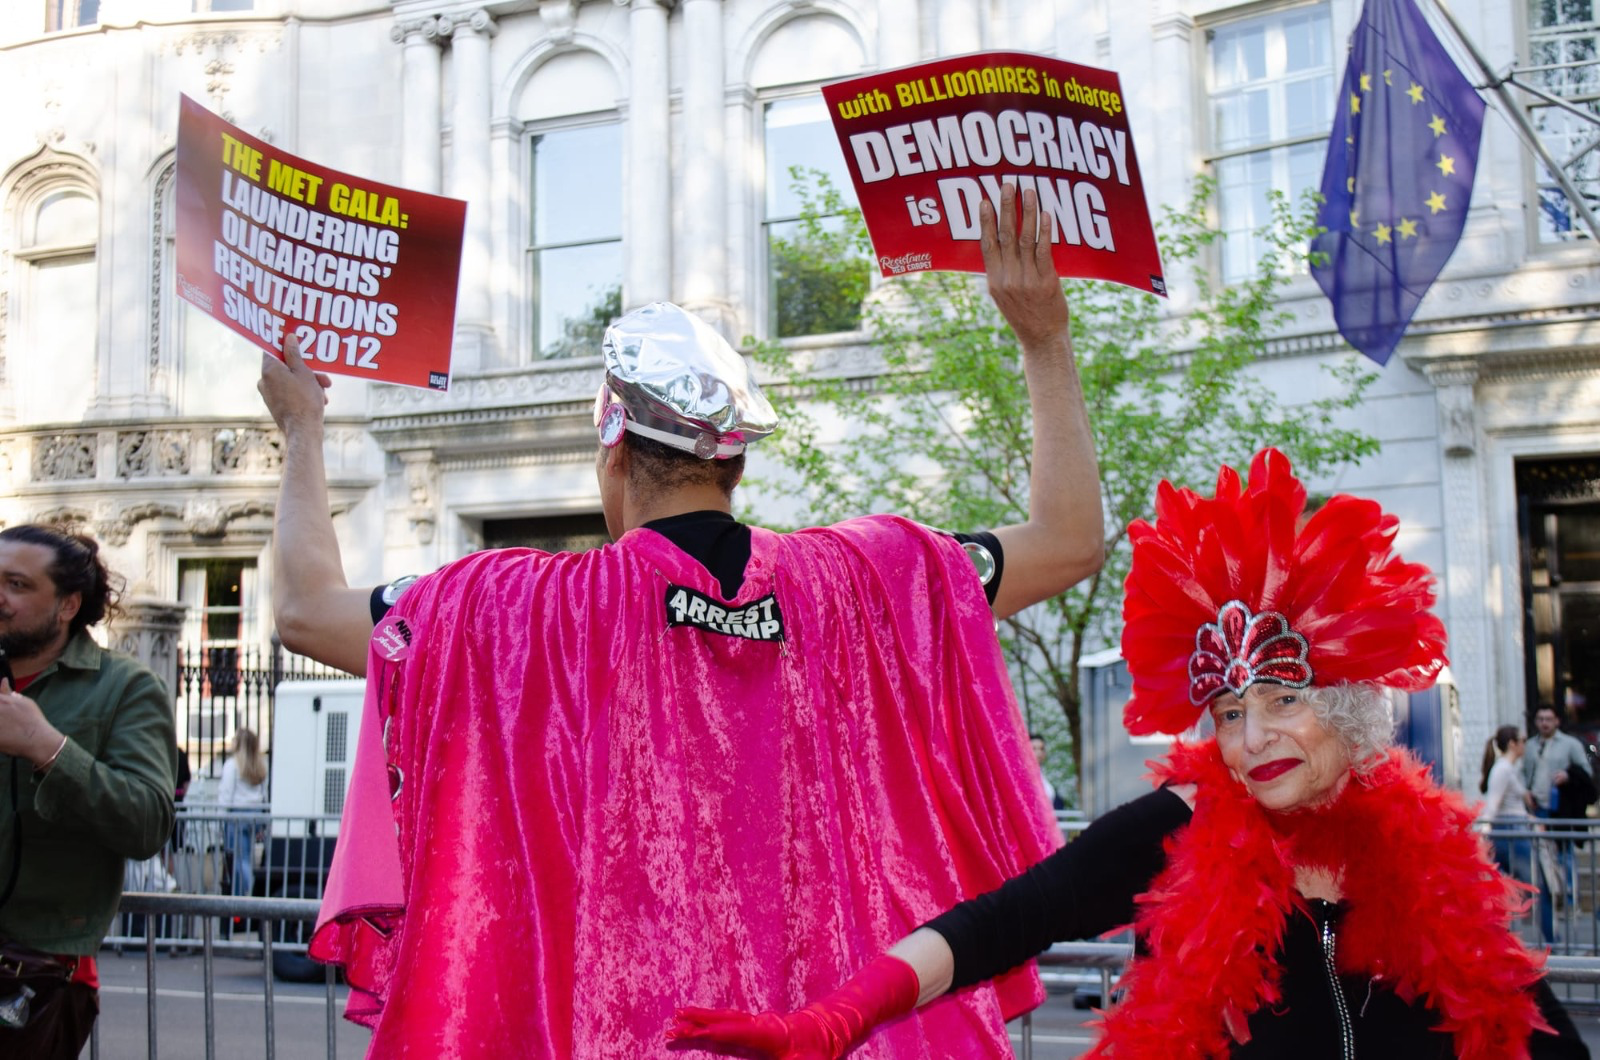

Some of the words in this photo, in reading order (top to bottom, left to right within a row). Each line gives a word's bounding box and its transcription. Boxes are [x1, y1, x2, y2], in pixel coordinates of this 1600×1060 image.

[838, 86, 892, 120] with
[895, 66, 1040, 108] BILLIONAIRES
[1042, 72, 1061, 99] in
[1064, 77, 1122, 117] charge
[221, 132, 263, 181] THE
[267, 159, 323, 206] MET
[329, 183, 409, 229] GALA:
[849, 109, 1131, 186] DEMOCRACY
[221, 169, 400, 264] LAUNDERING
[905, 195, 942, 227] is
[214, 240, 398, 337] REPUTATIONS
[222, 209, 391, 297] OLIGARCHS’
[222, 283, 286, 352] SINCE
[295, 325, 382, 370] 2012
[669, 589, 774, 624] ARREST
[675, 610, 780, 639] UMP
